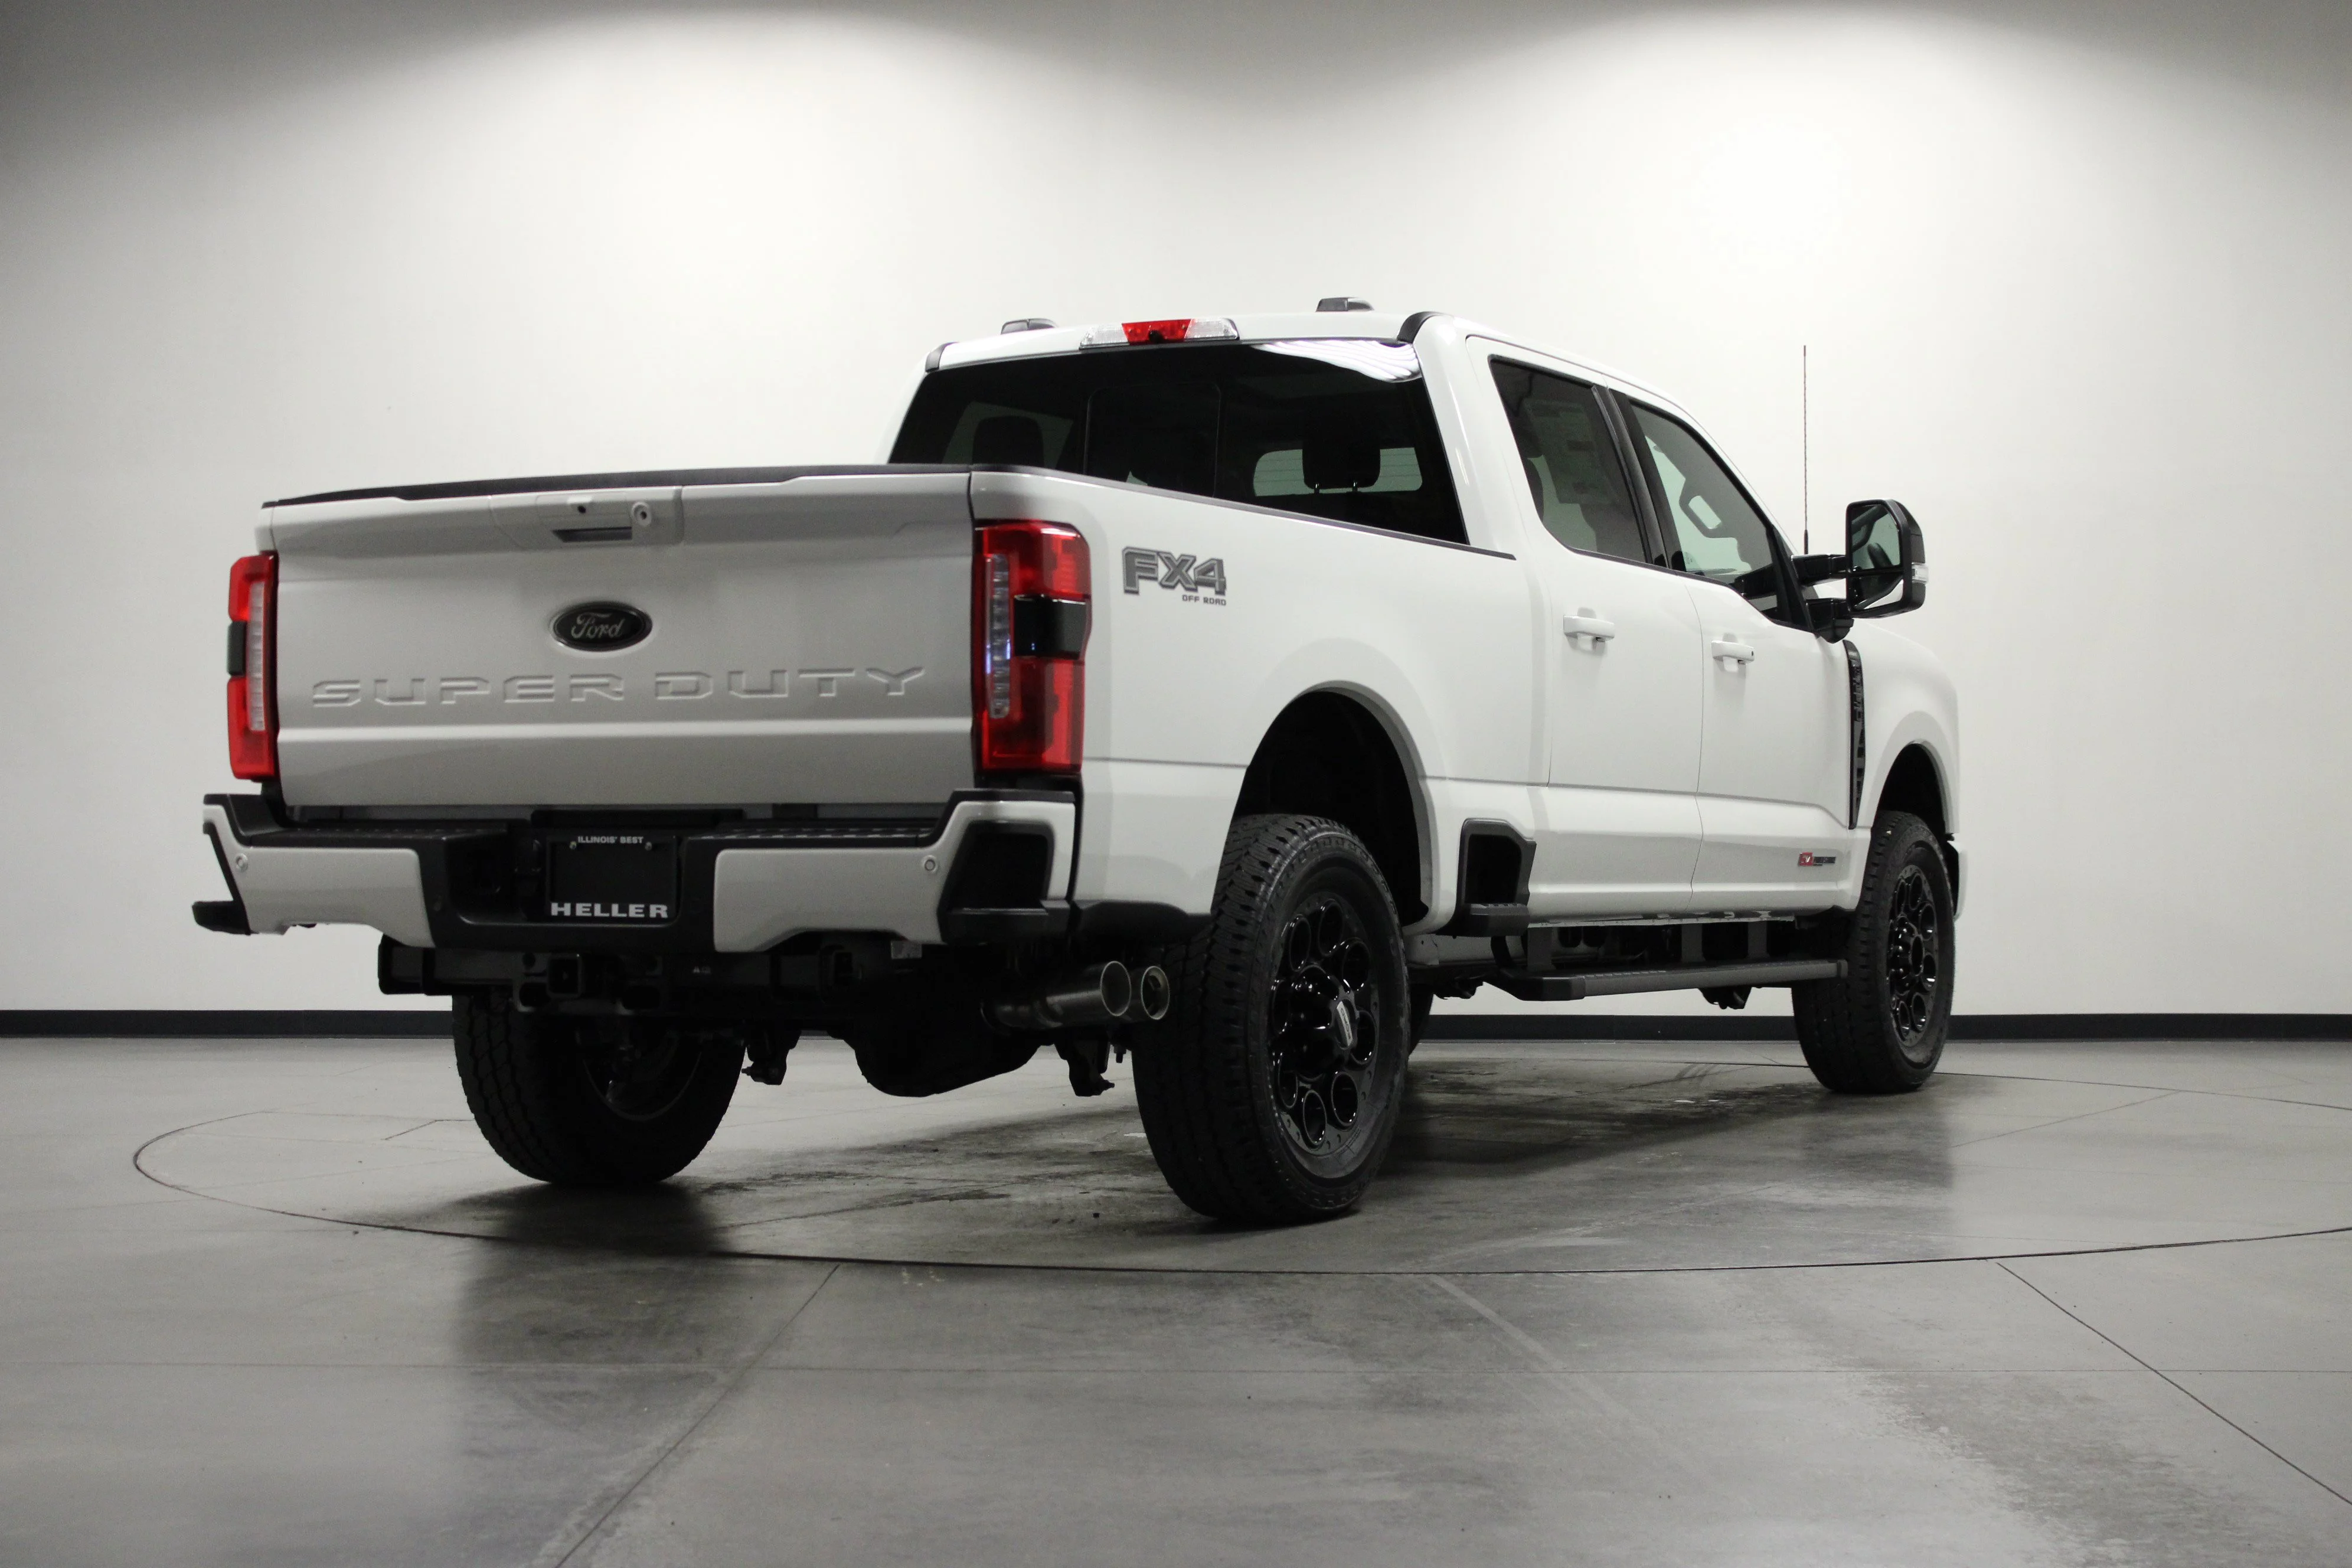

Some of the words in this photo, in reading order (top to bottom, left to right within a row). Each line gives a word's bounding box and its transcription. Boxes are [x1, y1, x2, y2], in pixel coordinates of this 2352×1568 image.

[1122, 546, 1226, 595] FX4
[1182, 594, 1200, 603] OFF
[1203, 597, 1226, 606] ROAD
[571, 612, 625, 639] Ford
[312, 673, 625, 707] SUPER
[655, 667, 925, 700] DUTY
[551, 902, 668, 919] HELLER
